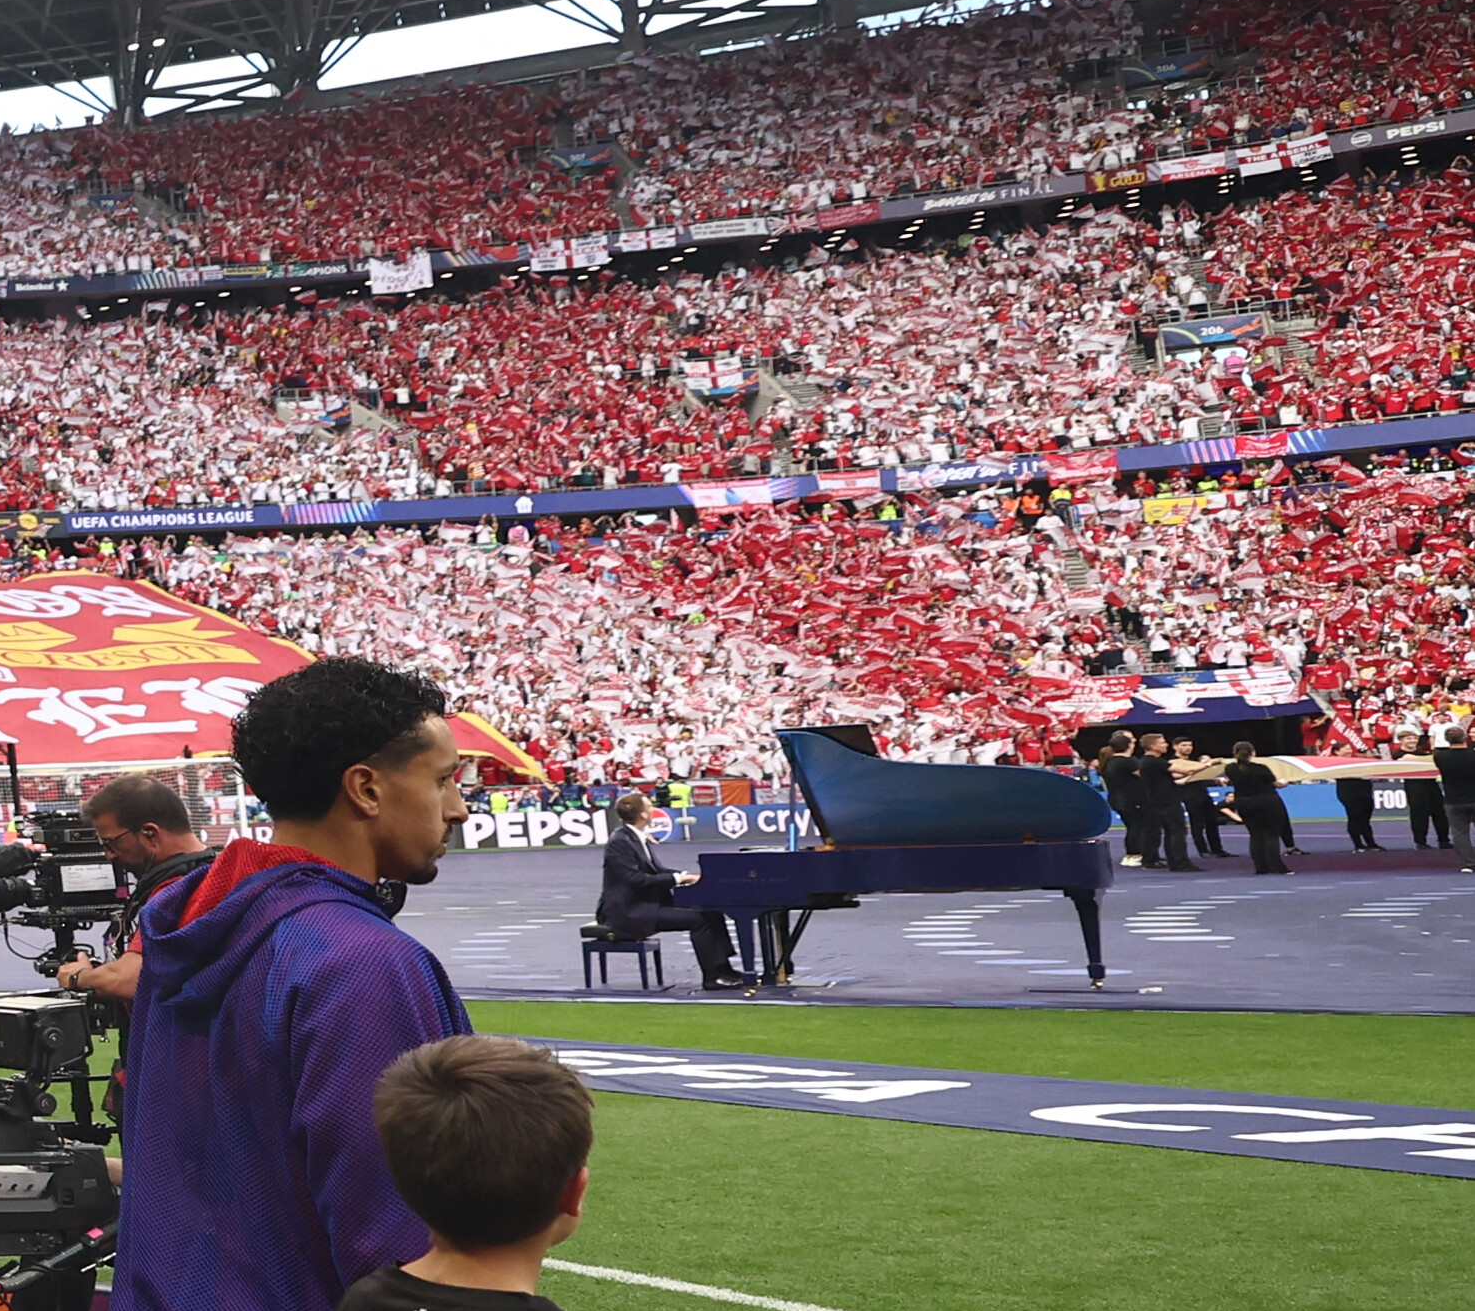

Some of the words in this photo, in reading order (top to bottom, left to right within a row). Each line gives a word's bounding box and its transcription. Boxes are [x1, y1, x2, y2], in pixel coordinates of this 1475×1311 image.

[1386, 119, 1446, 140] PEPSI
[1245, 154, 1267, 163] THE
[1270, 142, 1323, 159] ARSENAL
[1169, 167, 1219, 180] ARSENAL
[1000, 183, 1054, 199] FINAL
[1200, 325, 1225, 337] 206
[71, 516, 108, 530] UEFA
[109, 512, 196, 528] CHAMPIONS
[197, 510, 255, 525] LEAGUE
[0, 644, 224, 669] CRESCIT
[1373, 790, 1407, 809] FOO
[462, 809, 610, 850] PEPSI
[757, 808, 821, 837] cry
[555, 1047, 971, 1105] EFA
